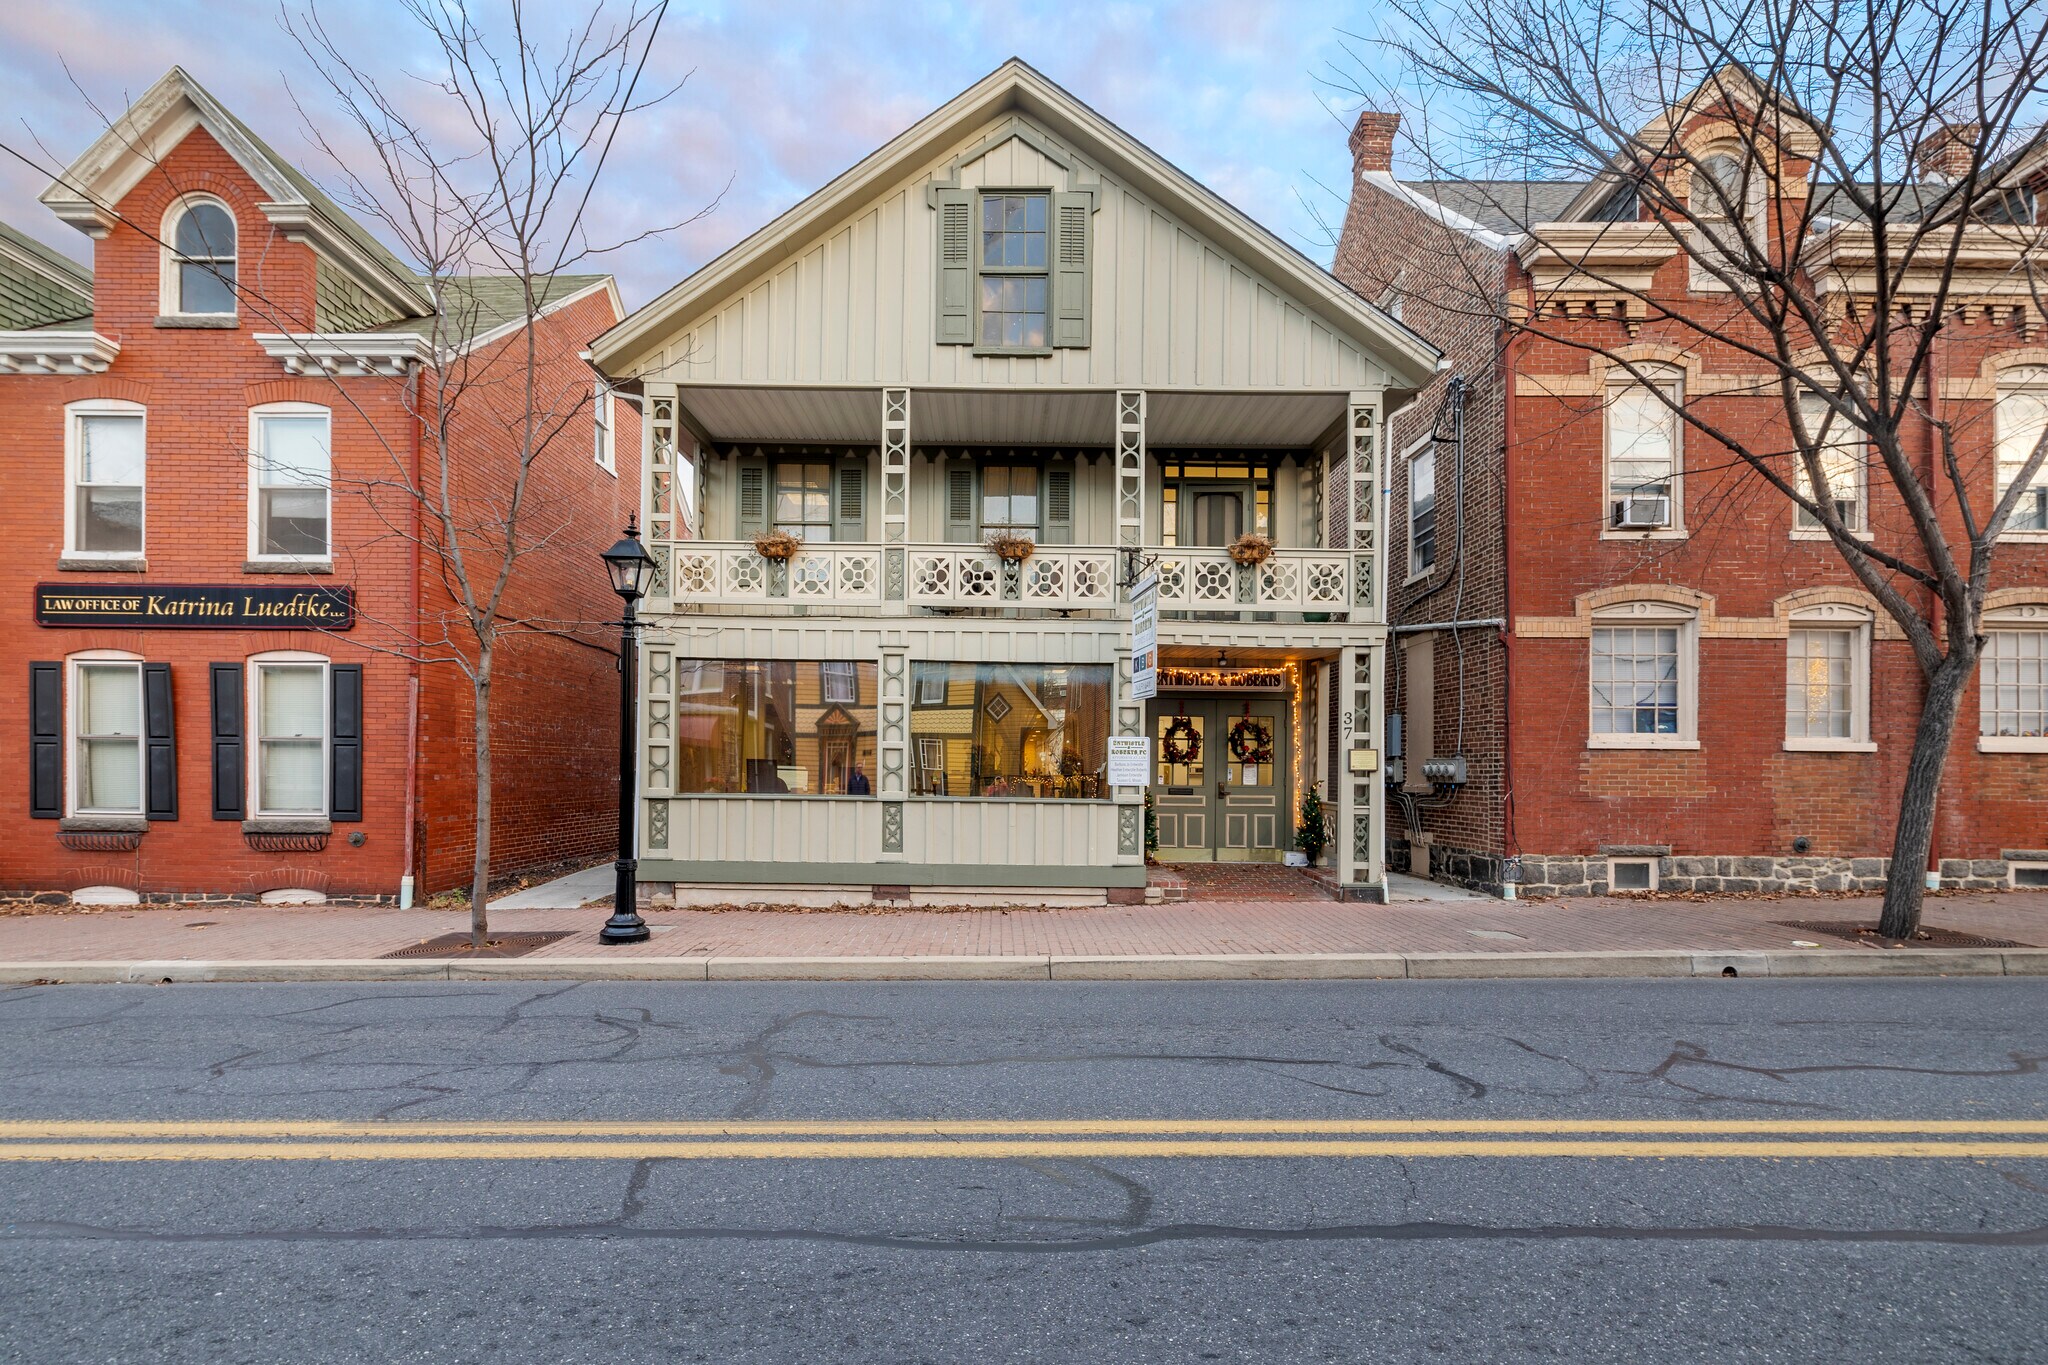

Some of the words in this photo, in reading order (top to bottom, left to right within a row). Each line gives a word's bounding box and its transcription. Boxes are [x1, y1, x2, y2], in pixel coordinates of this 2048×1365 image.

[45, 599, 74, 610] LAW
[75, 599, 120, 611] OFFICE
[122, 599, 140, 611] OF
[146, 595, 234, 616] Katrina
[242, 593, 331, 617] Luedtke
[1218, 672, 1228, 686] &
[1230, 671, 1281, 686] ROBERTS
